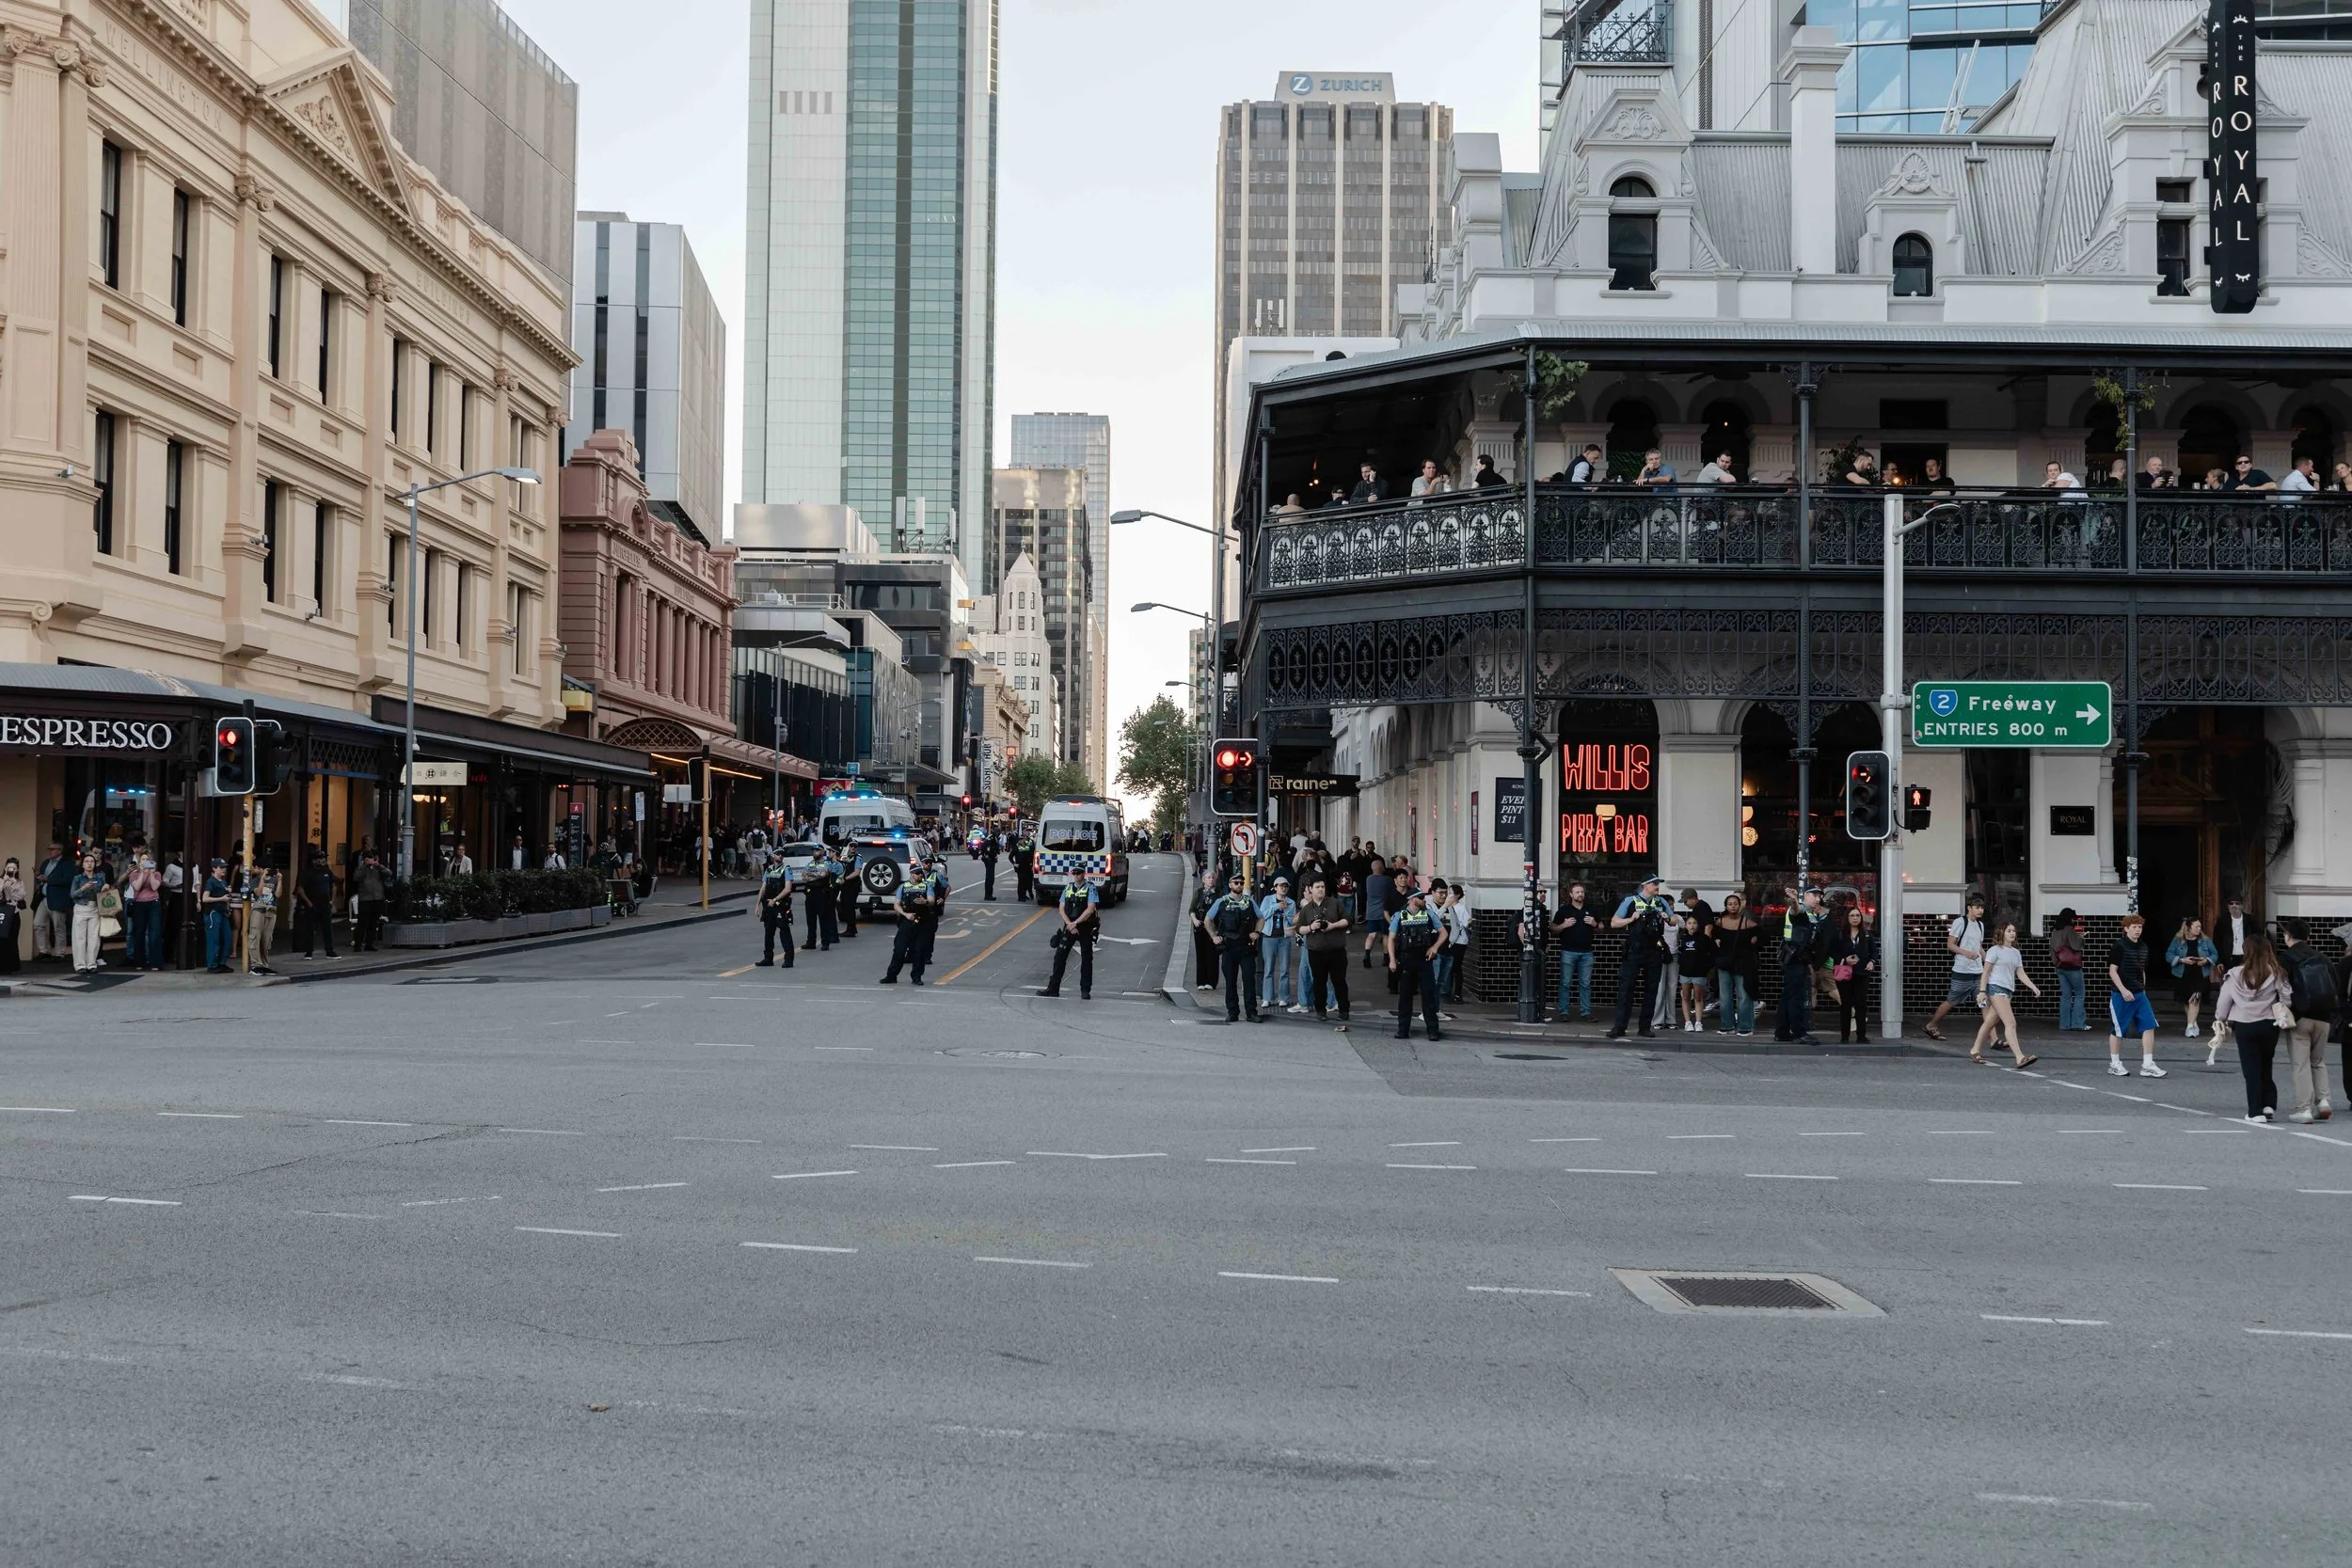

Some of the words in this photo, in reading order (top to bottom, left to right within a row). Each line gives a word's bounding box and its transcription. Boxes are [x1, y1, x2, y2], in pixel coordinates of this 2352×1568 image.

[105, 20, 222, 132] WELLINGTON
[1319, 78, 1384, 91] ZURICH
[2211, 81, 2223, 247] ROYAL
[2230, 74, 2252, 242] ROYAL
[1937, 694, 1950, 709] 2
[1968, 695, 2058, 715] Freeway
[0, 716, 172, 750] ESPRESSO
[1923, 722, 1999, 736] ENTRIES
[2009, 722, 2045, 736] 800
[2054, 725, 2068, 736] m
[983, 742, 993, 760] HUB
[983, 767, 992, 790] SUSHI
[1285, 778, 1329, 790] raine
[1500, 805, 1524, 815] PINT
[1500, 815, 1517, 824] $11
[2059, 815, 2087, 824] ROYAL
[1049, 829, 1098, 841] POLICE
[1562, 814, 1608, 853] PIZZA
[1614, 815, 1648, 853] BAR
